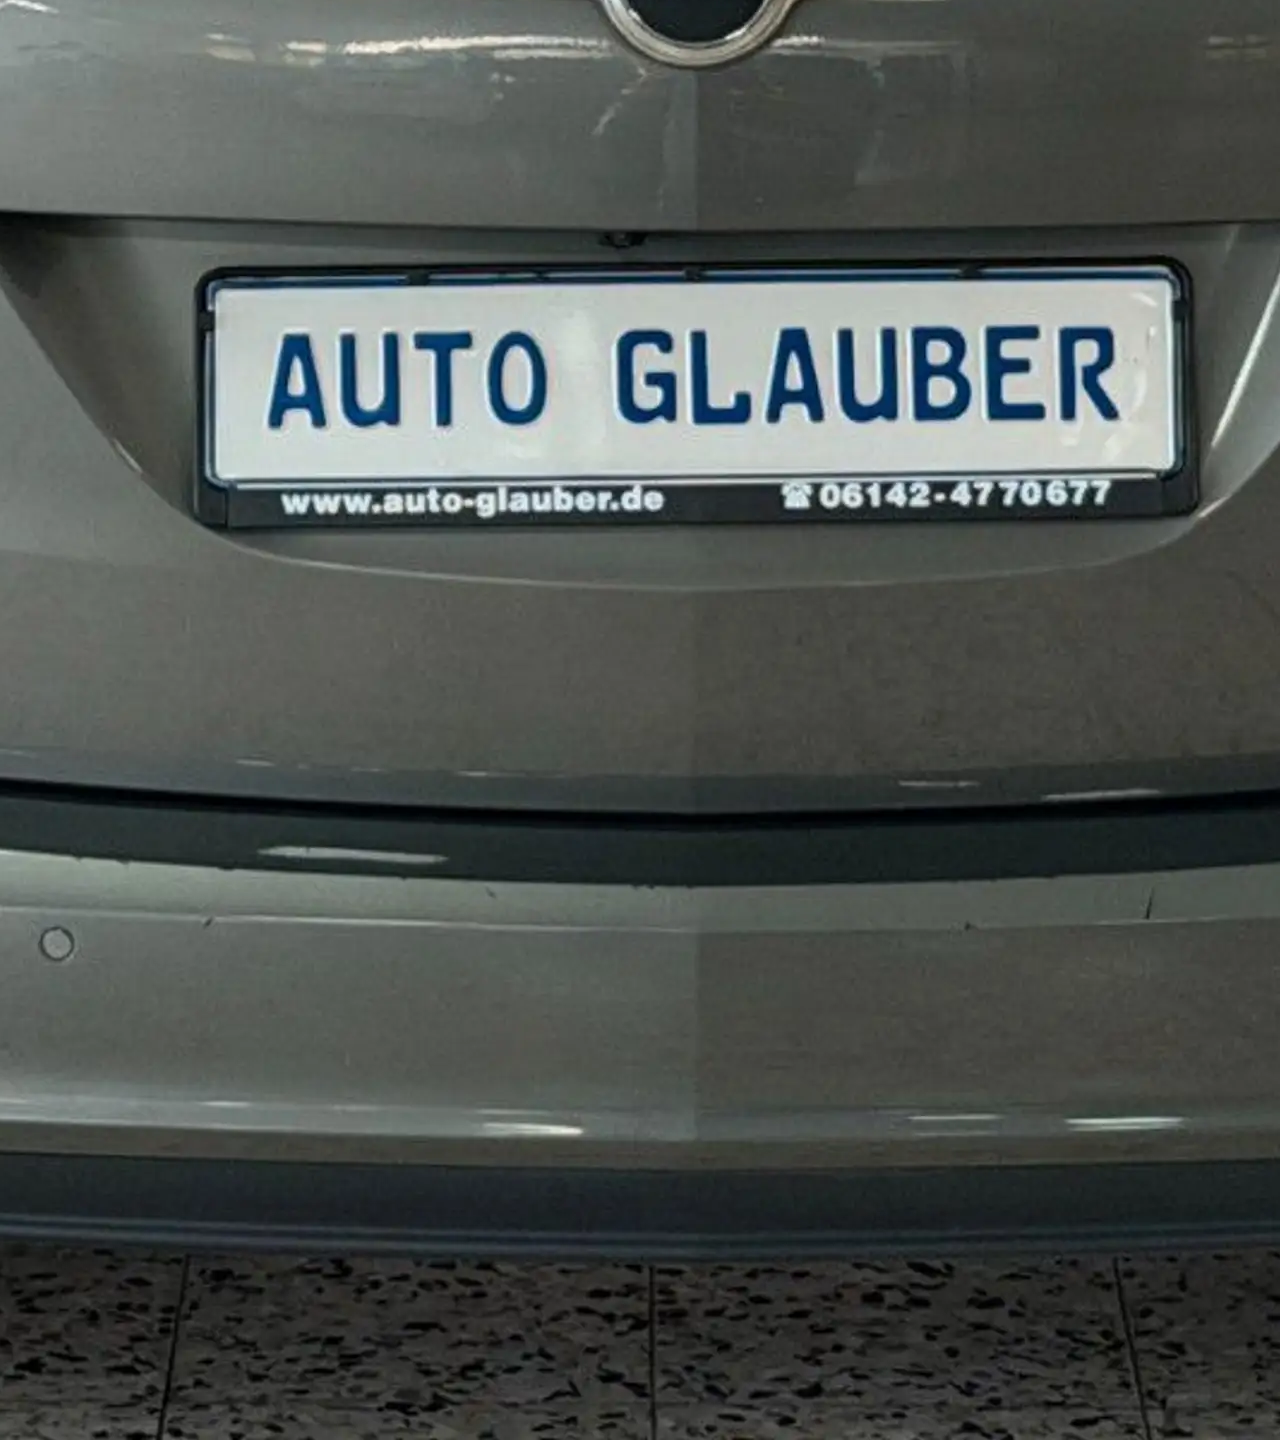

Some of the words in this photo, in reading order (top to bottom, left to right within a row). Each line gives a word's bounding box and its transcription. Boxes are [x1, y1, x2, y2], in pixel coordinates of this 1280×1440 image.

[267, 331, 547, 428] AUTO
[617, 325, 1121, 425] GLAUBER
[281, 486, 665, 517] www.auto-glauber.de
[820, 479, 1111, 508] 06142-4770677
